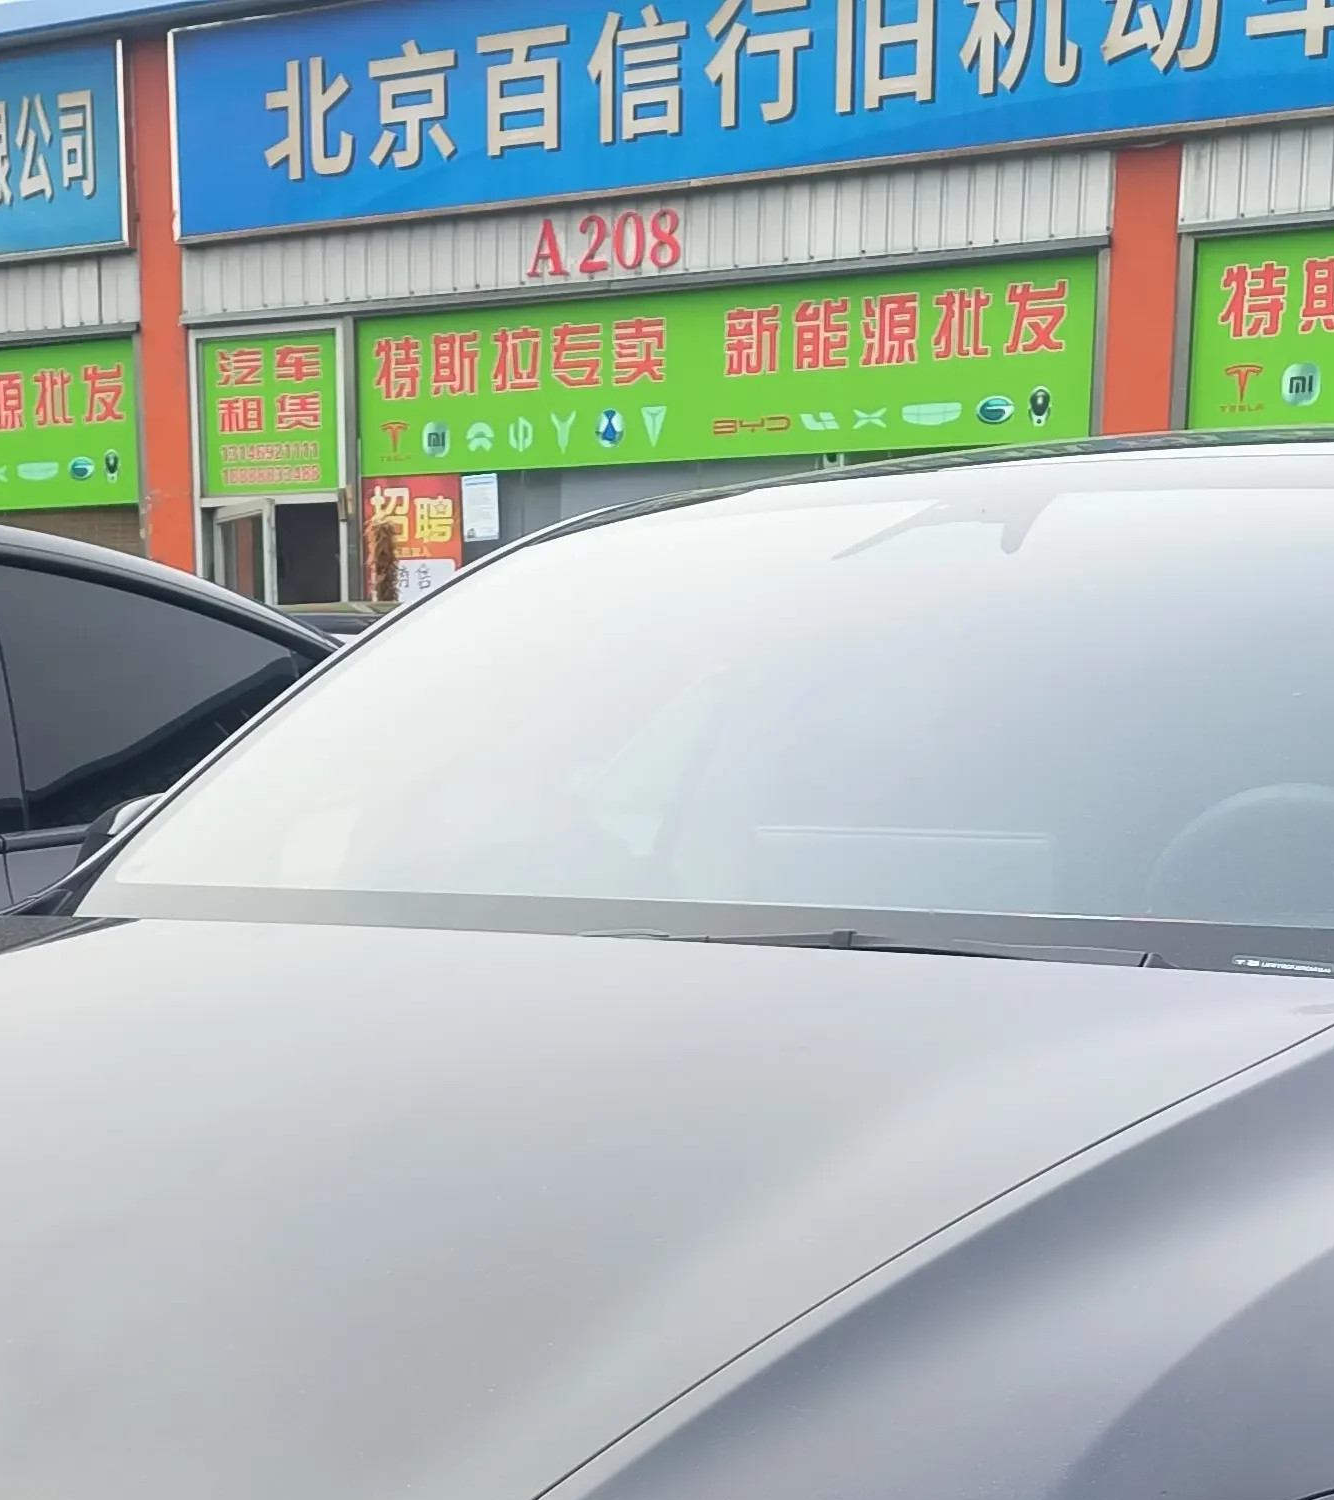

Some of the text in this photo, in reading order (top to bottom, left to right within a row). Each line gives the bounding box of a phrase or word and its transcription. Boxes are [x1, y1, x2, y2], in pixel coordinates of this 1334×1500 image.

[526, 209, 683, 279] A208
[372, 279, 1070, 400] 特斯拉专卖 新能源批发
[216, 345, 323, 388] 汽车
[217, 391, 323, 434] 租赁
[712, 414, 793, 437] BYD
[369, 485, 455, 543] 招聘
